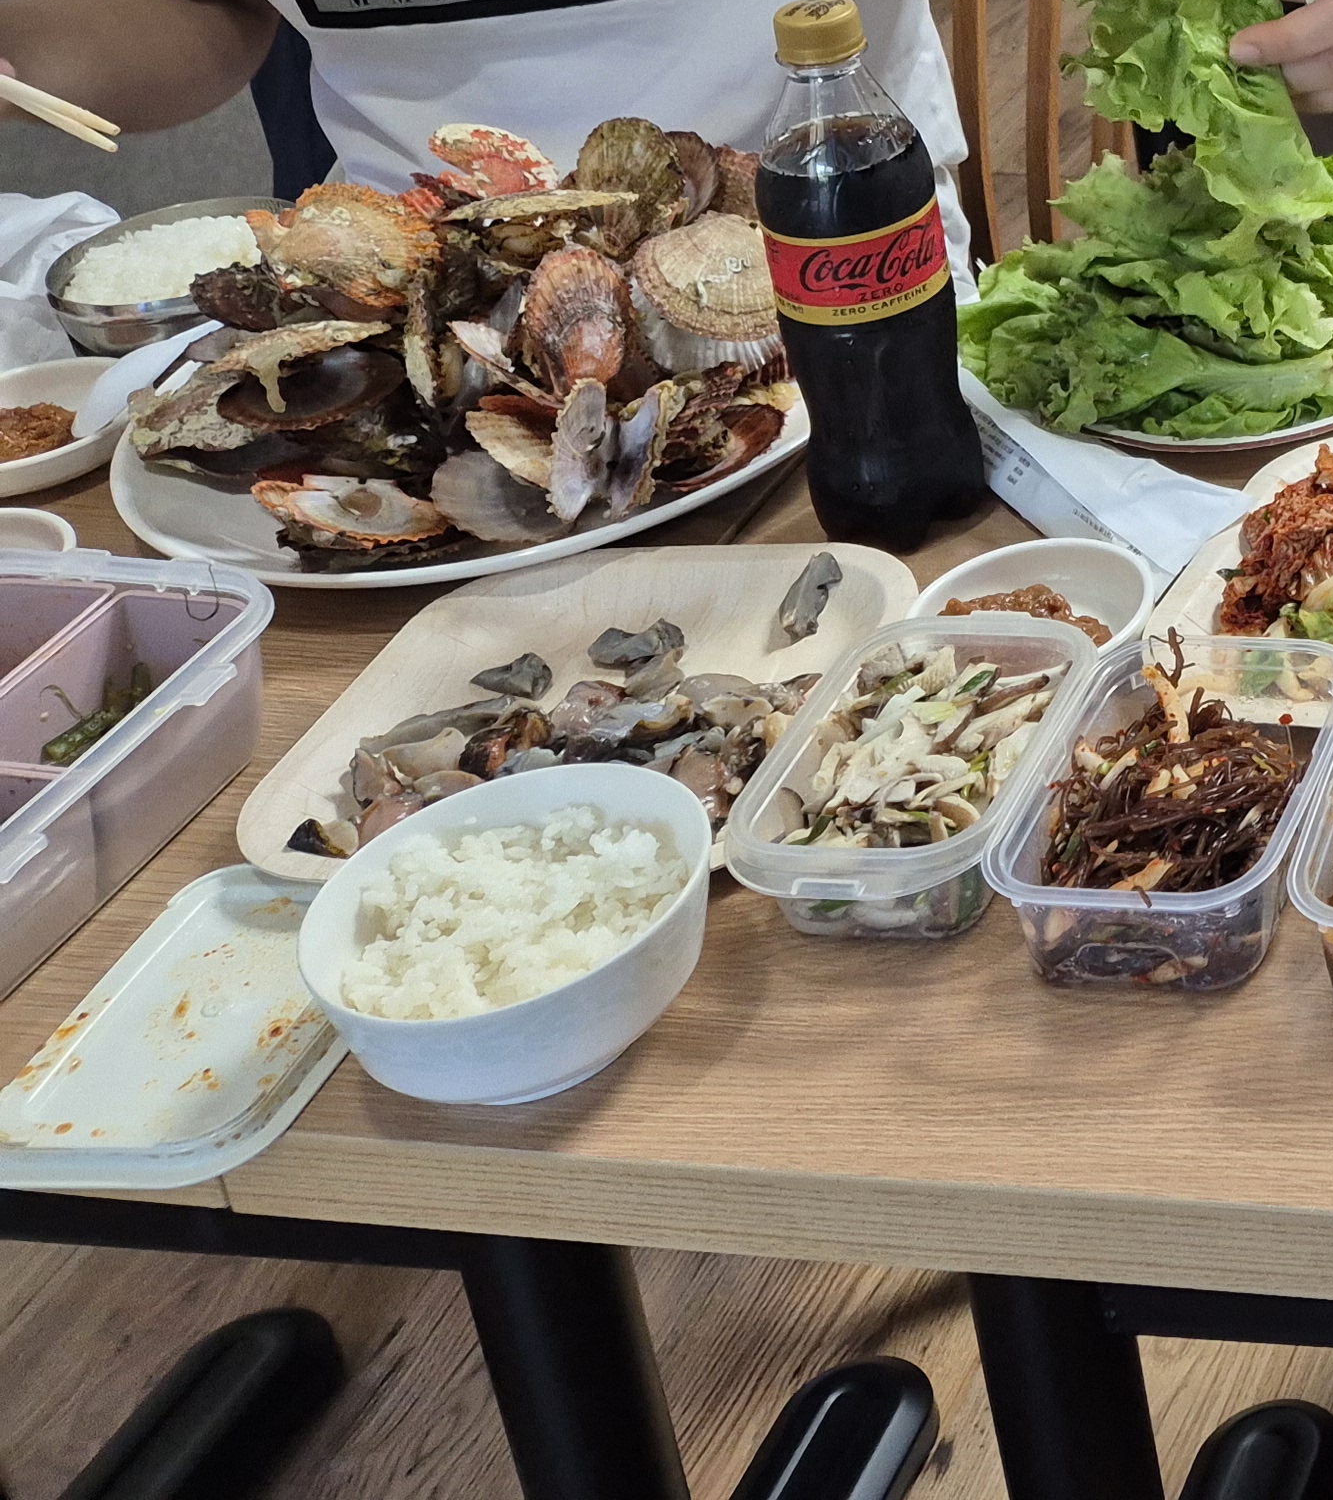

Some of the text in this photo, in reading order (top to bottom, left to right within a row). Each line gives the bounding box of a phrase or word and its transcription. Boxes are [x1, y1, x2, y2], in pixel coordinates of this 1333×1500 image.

[799, 222, 936, 293] Coca-Cola
[831, 283, 929, 317] ZERO CAFFEINE
[858, 282, 904, 303] ZERO
